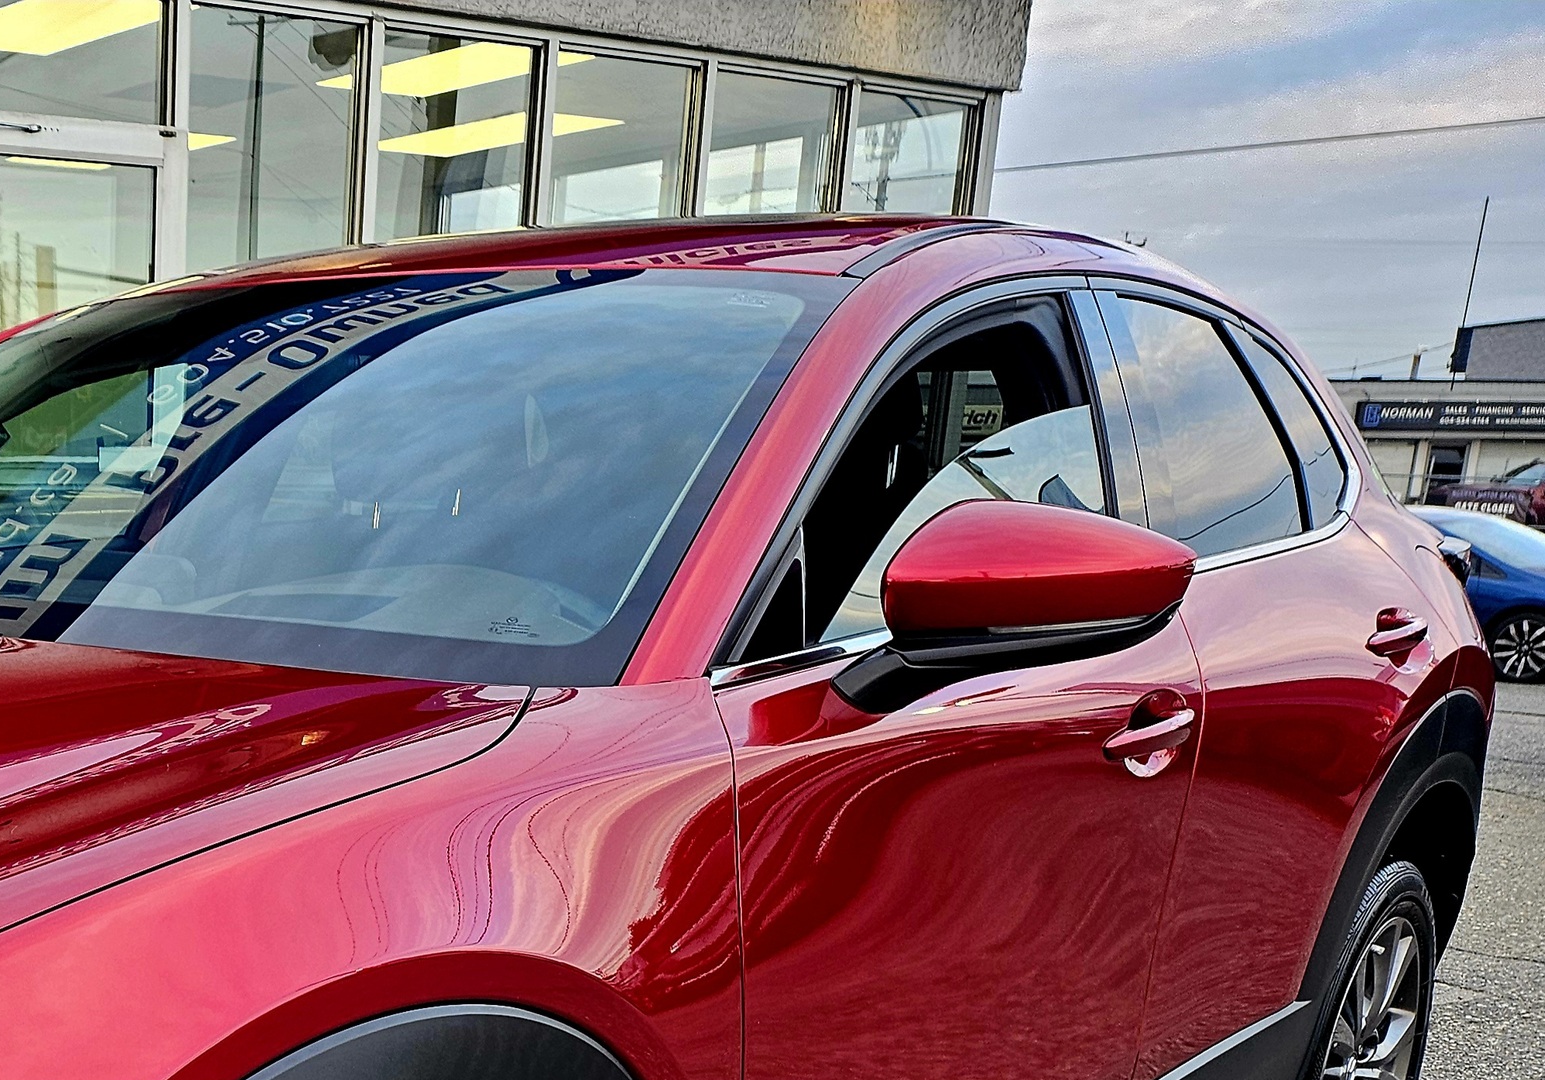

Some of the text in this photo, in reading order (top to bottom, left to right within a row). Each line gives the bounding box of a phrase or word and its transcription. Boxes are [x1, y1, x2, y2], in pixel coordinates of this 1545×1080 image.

[1380, 407, 1434, 419] NORMAN
[1445, 406, 1467, 415] SALES
[1475, 406, 1514, 415] FINANCING
[1480, 503, 1515, 514] CLOSED
